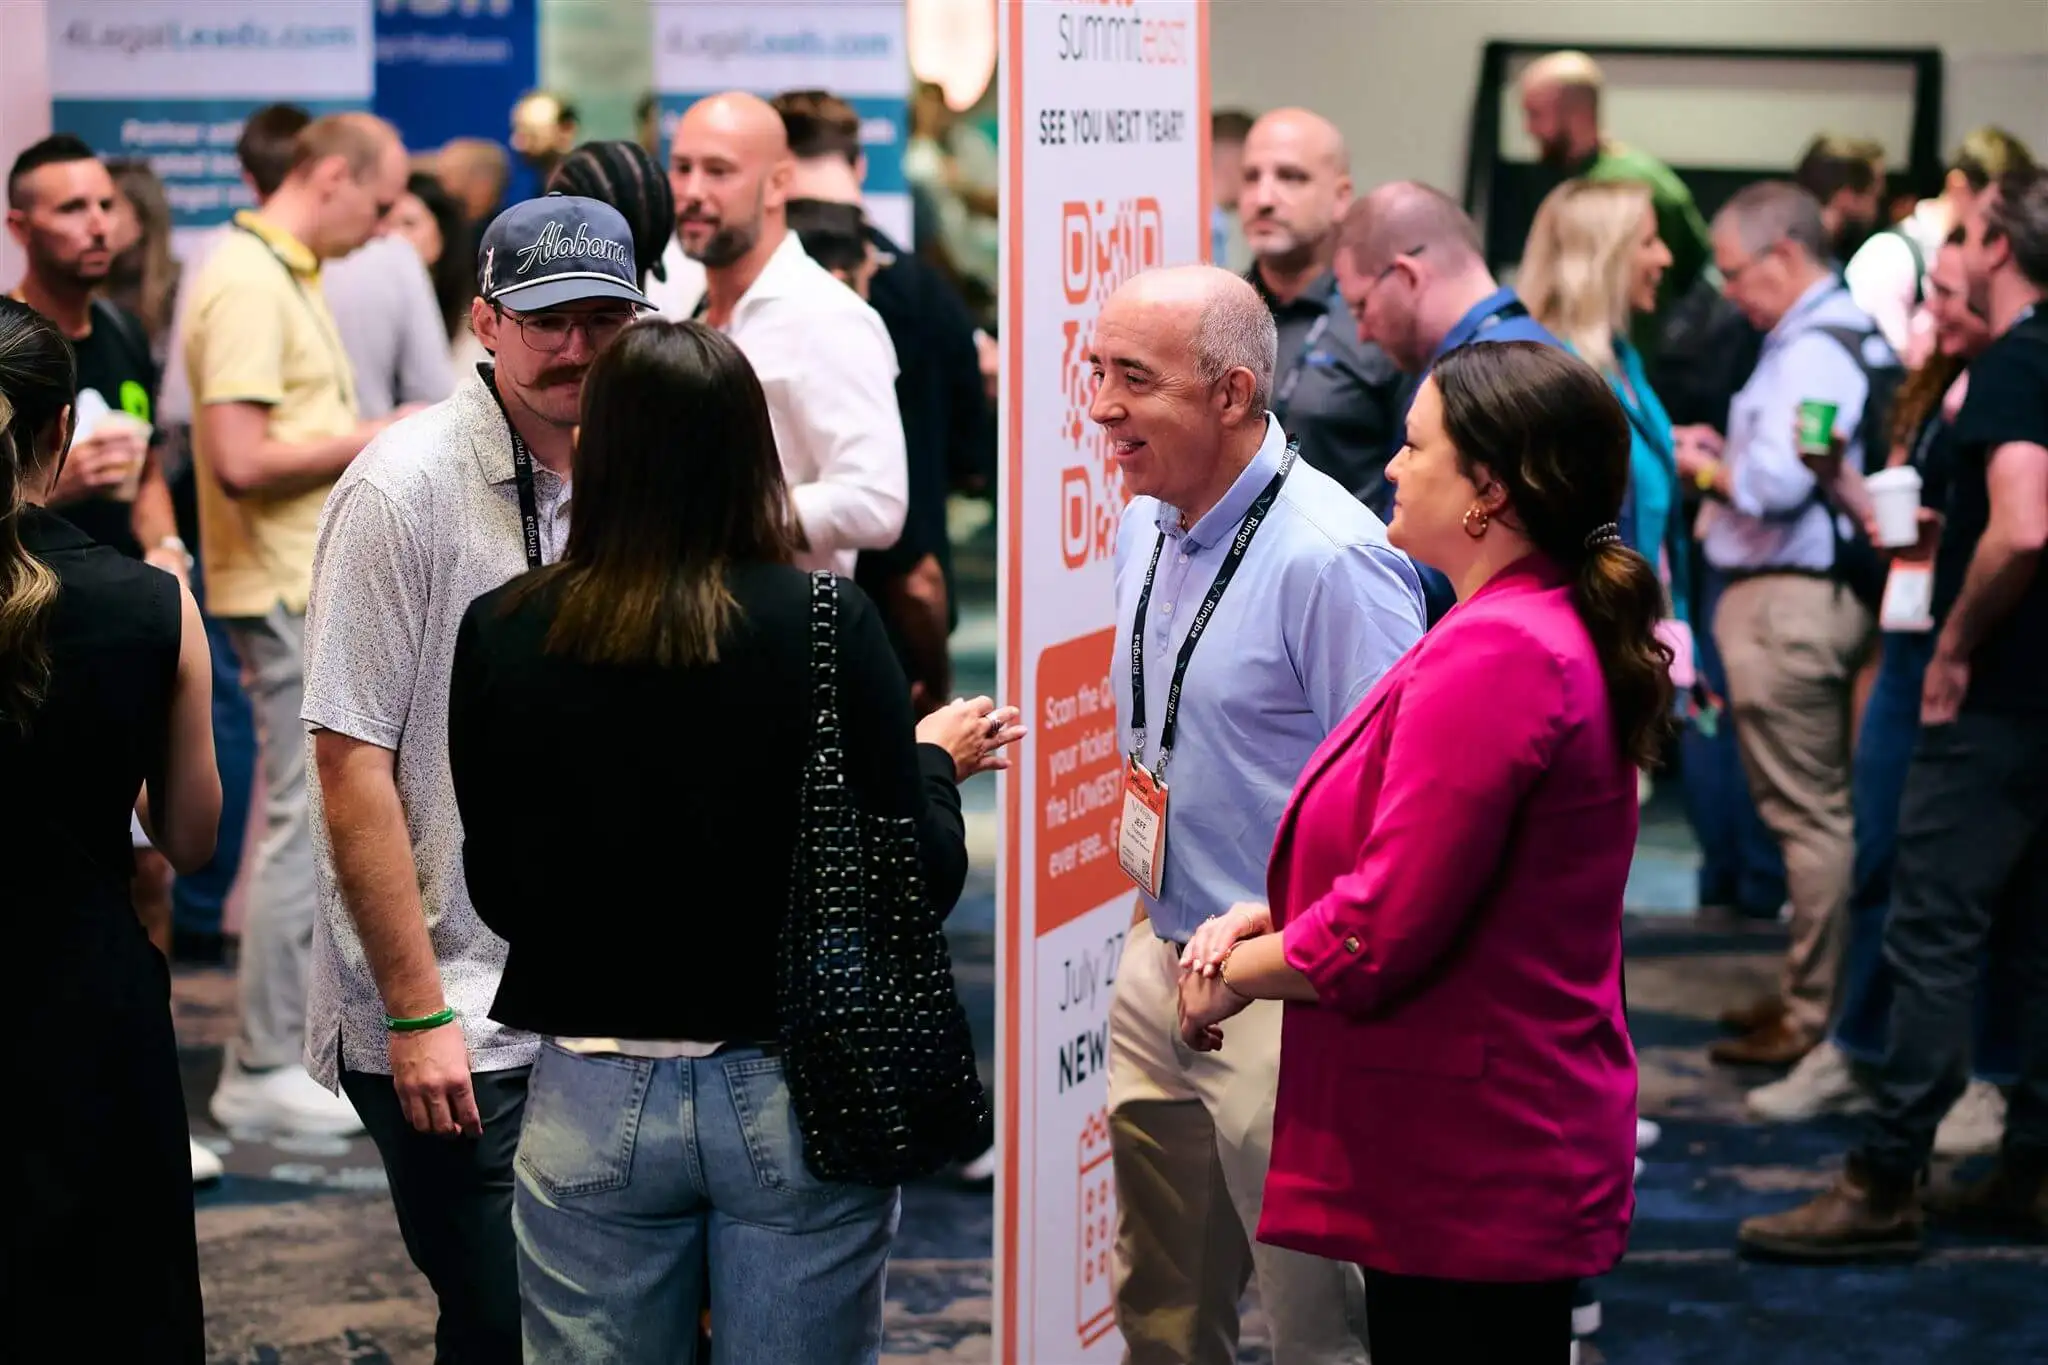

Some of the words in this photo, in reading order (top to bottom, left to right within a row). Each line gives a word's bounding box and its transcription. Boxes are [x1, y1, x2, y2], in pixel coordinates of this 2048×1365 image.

[1039, 109, 1066, 145] SEE
[1071, 109, 1101, 144] YOU
[1106, 109, 1141, 143] NEXT
[517, 221, 627, 274] Alabama
[514, 433, 526, 465] Ring
[526, 515, 537, 557] Ringba
[1233, 517, 1259, 556] Ringba
[1190, 599, 1215, 639] Ringba
[1132, 633, 1141, 675] Ringba
[1044, 695, 1076, 730] Scan
[1078, 684, 1099, 715] the
[1167, 684, 1180, 723] Ringba
[1049, 746, 1078, 786] your
[1045, 796, 1067, 829] the
[1070, 769, 1122, 819] LOWEST
[1049, 844, 1078, 879] ever
[1060, 949, 1100, 1011] July
[1059, 1021, 1107, 1094] NEW
